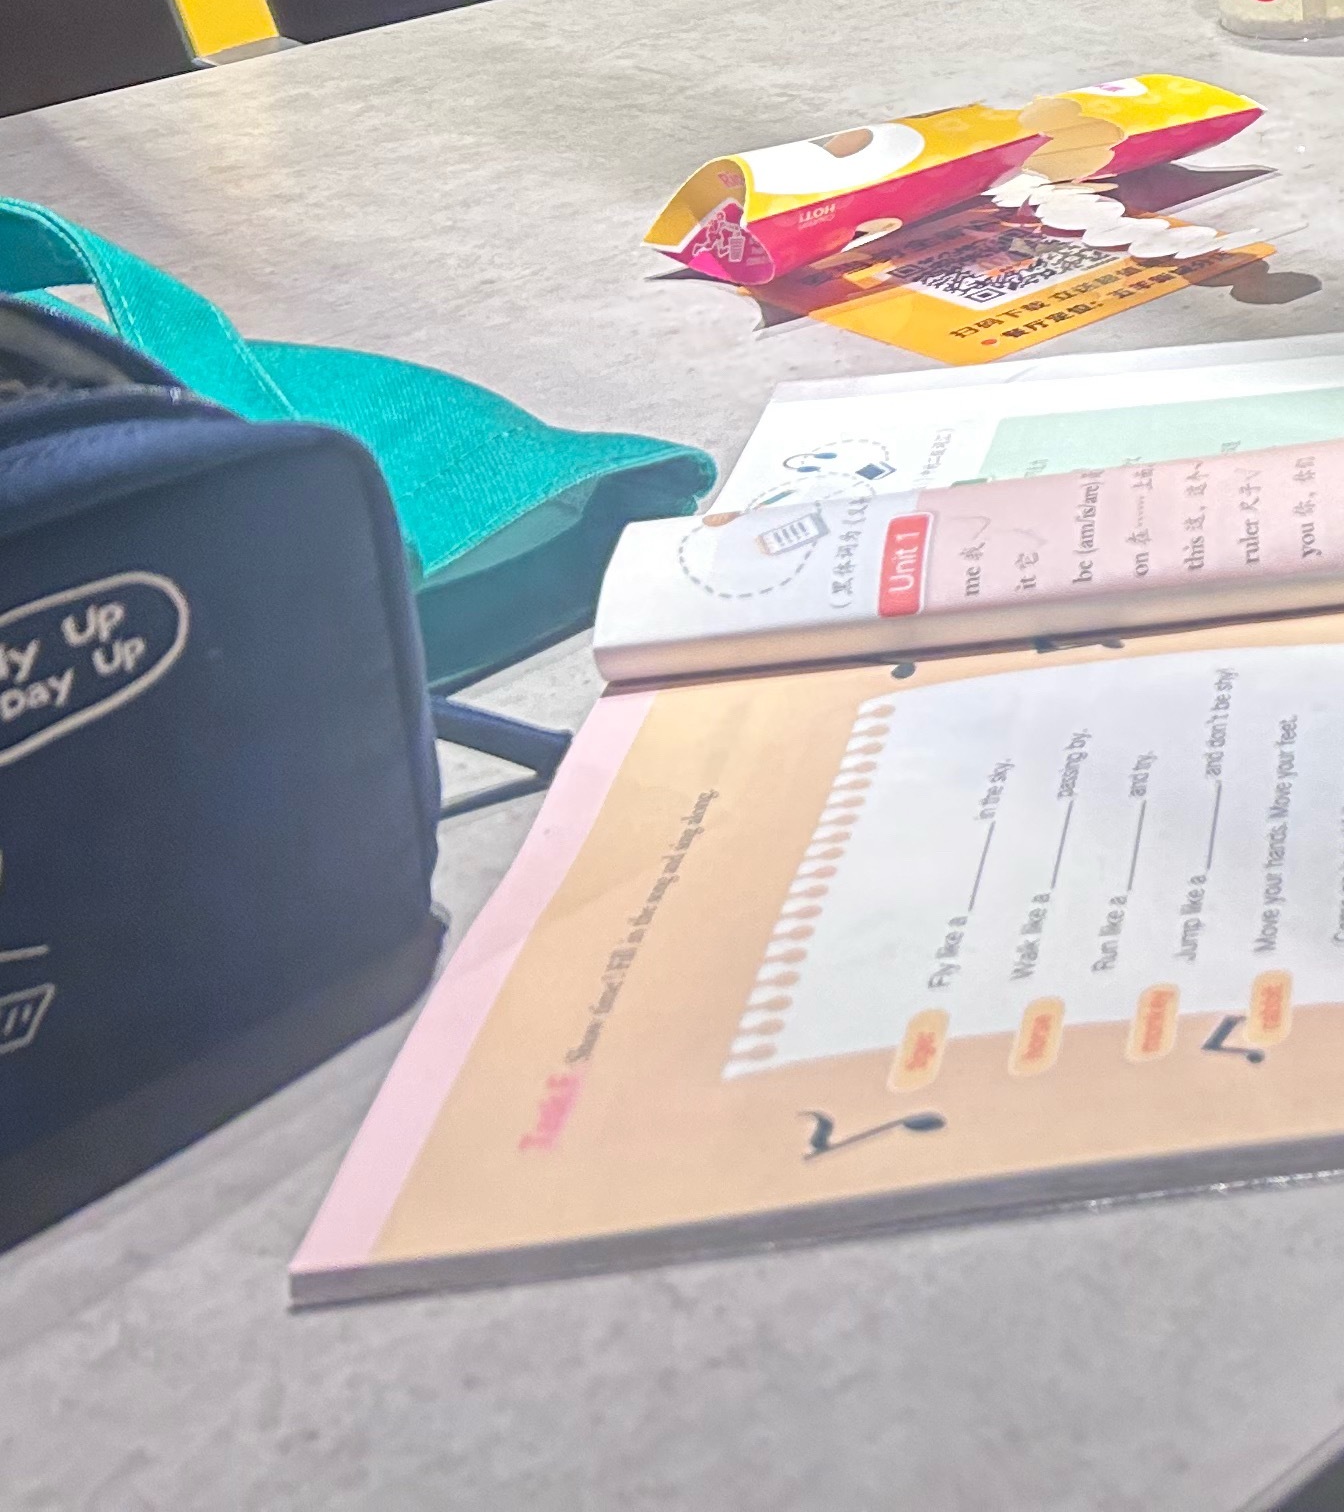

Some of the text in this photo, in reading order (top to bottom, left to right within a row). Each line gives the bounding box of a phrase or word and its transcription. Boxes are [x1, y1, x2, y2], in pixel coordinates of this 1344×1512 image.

[1237, 482, 1262, 566] ruler 尺子
[1299, 522, 1323, 559] you
[888, 531, 920, 593] Unit 1
[1133, 551, 1150, 577] on
[1182, 535, 1207, 571] this
[963, 566, 981, 597] me
[1013, 551, 1039, 592] it 它
[1072, 560, 1094, 584] be
[1252, 714, 1298, 954] Move your hands. Move your feet.
[1178, 889, 1204, 915] like
[1019, 908, 1048, 934] like
[1100, 910, 1125, 936] like
[1091, 940, 1117, 972] Run
[1174, 919, 1202, 963] Jump
[927, 963, 960, 989] Fly
[1009, 940, 1040, 981] Walk
